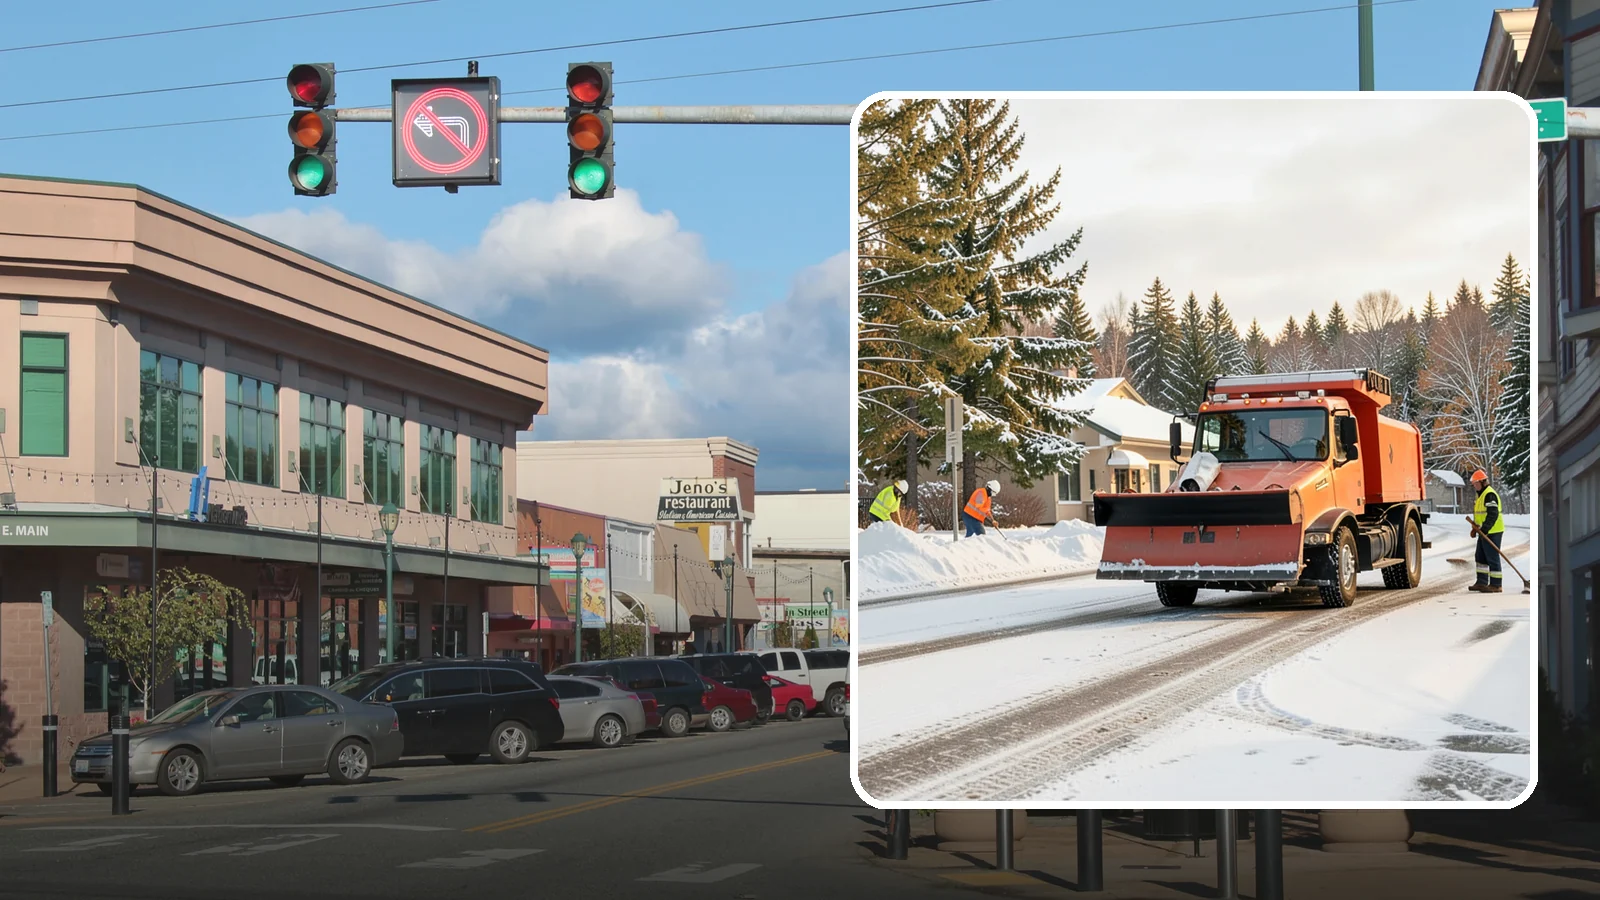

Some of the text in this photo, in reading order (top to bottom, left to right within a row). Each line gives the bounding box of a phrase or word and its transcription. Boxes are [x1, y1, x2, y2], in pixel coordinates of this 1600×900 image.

[670, 480, 728, 495] Jeno's
[665, 496, 731, 509] restaurant
[658, 509, 682, 520] Italian
[686, 509, 715, 520] American
[715, 509, 738, 519] Cuisine
[2, 525, 49, 536] E. MAIN
[797, 607, 829, 617] Street
